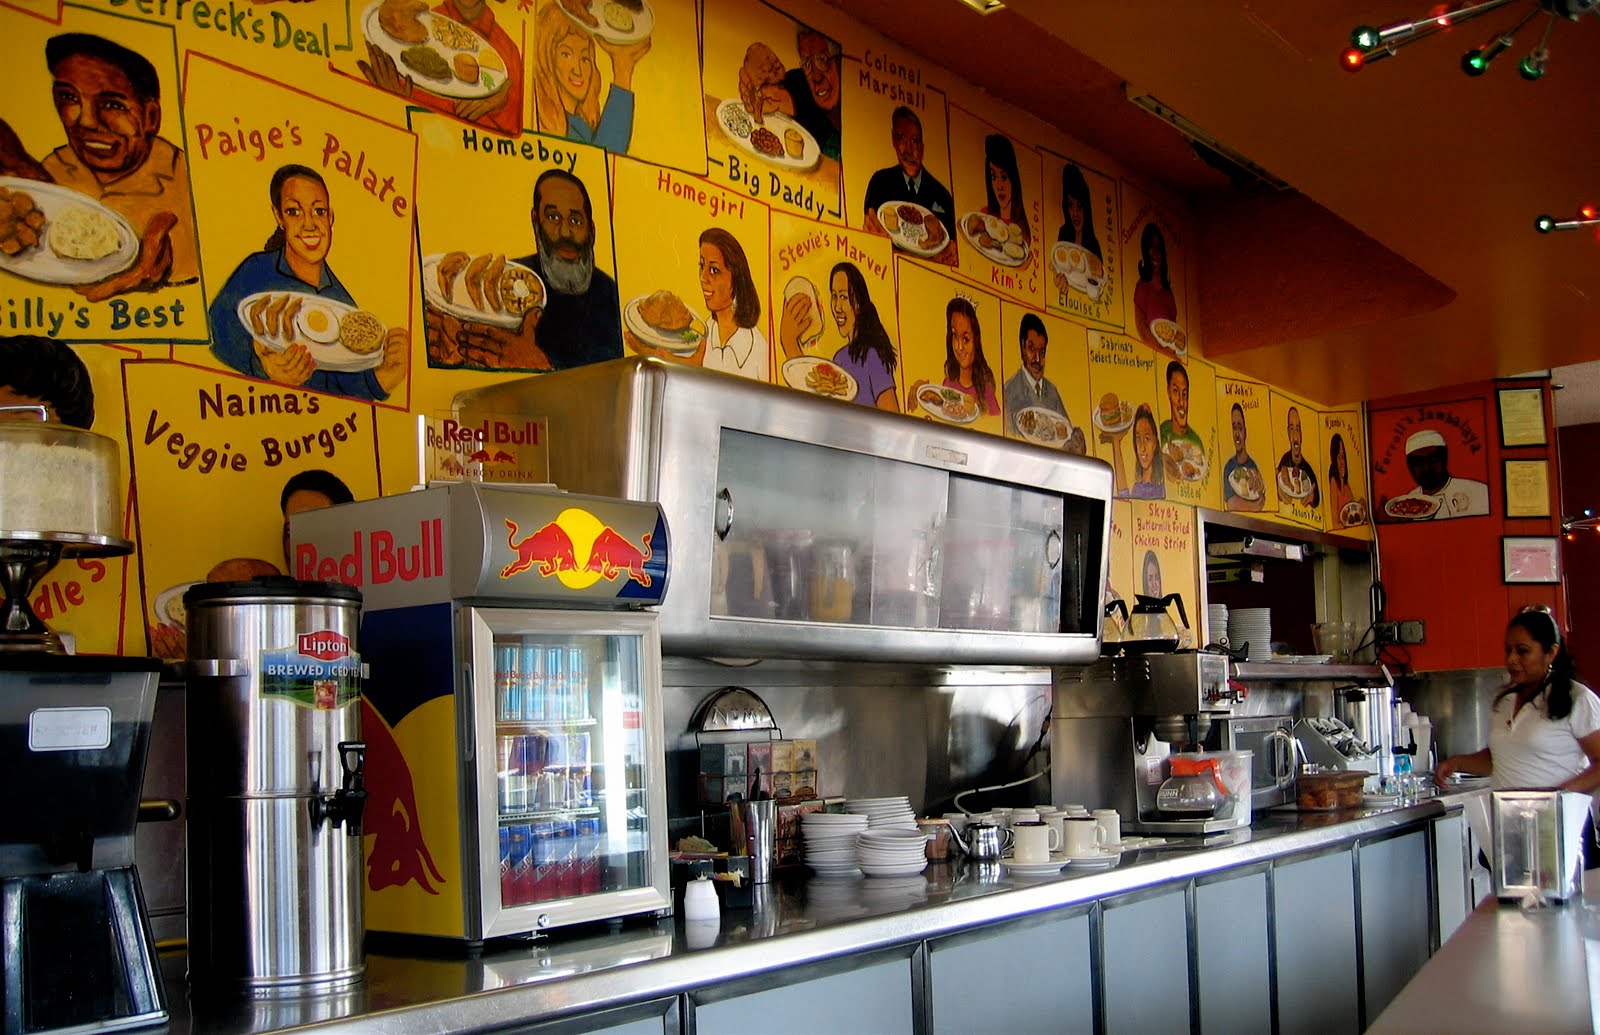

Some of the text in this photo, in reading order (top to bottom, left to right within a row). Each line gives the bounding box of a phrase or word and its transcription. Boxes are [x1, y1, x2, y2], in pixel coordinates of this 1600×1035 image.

[271, 11, 331, 58] Deal
[864, 50, 922, 87] Colonel
[858, 69, 926, 111] Marshall
[195, 118, 408, 218] Paige's Palate
[462, 129, 577, 174] Homeboy
[657, 169, 745, 220] Homegirl
[728, 155, 825, 218] Big Daddy
[778, 229, 887, 281] Stevie's Marvel
[990, 265, 1024, 292] Kim's
[0, 296, 185, 337] illy's Best
[1058, 292, 1101, 318] Elouise's
[1090, 350, 1112, 364] Select
[1100, 336, 1133, 353] Sabrina's
[199, 383, 321, 420] Naima's
[144, 409, 359, 474] Veggie Burger
[443, 418, 539, 446] Red Bull
[449, 467, 495, 479] ENERGY
[499, 469, 534, 480] DRINK
[1136, 517, 1190, 536] Buttermilk Fried
[1148, 502, 1179, 521] Skye's
[296, 518, 444, 587] Red Bull
[1134, 534, 1187, 552] Chicken Strips
[303, 637, 347, 654] Lipton
[268, 665, 323, 677] BREWED
[328, 666, 349, 677] ICED
